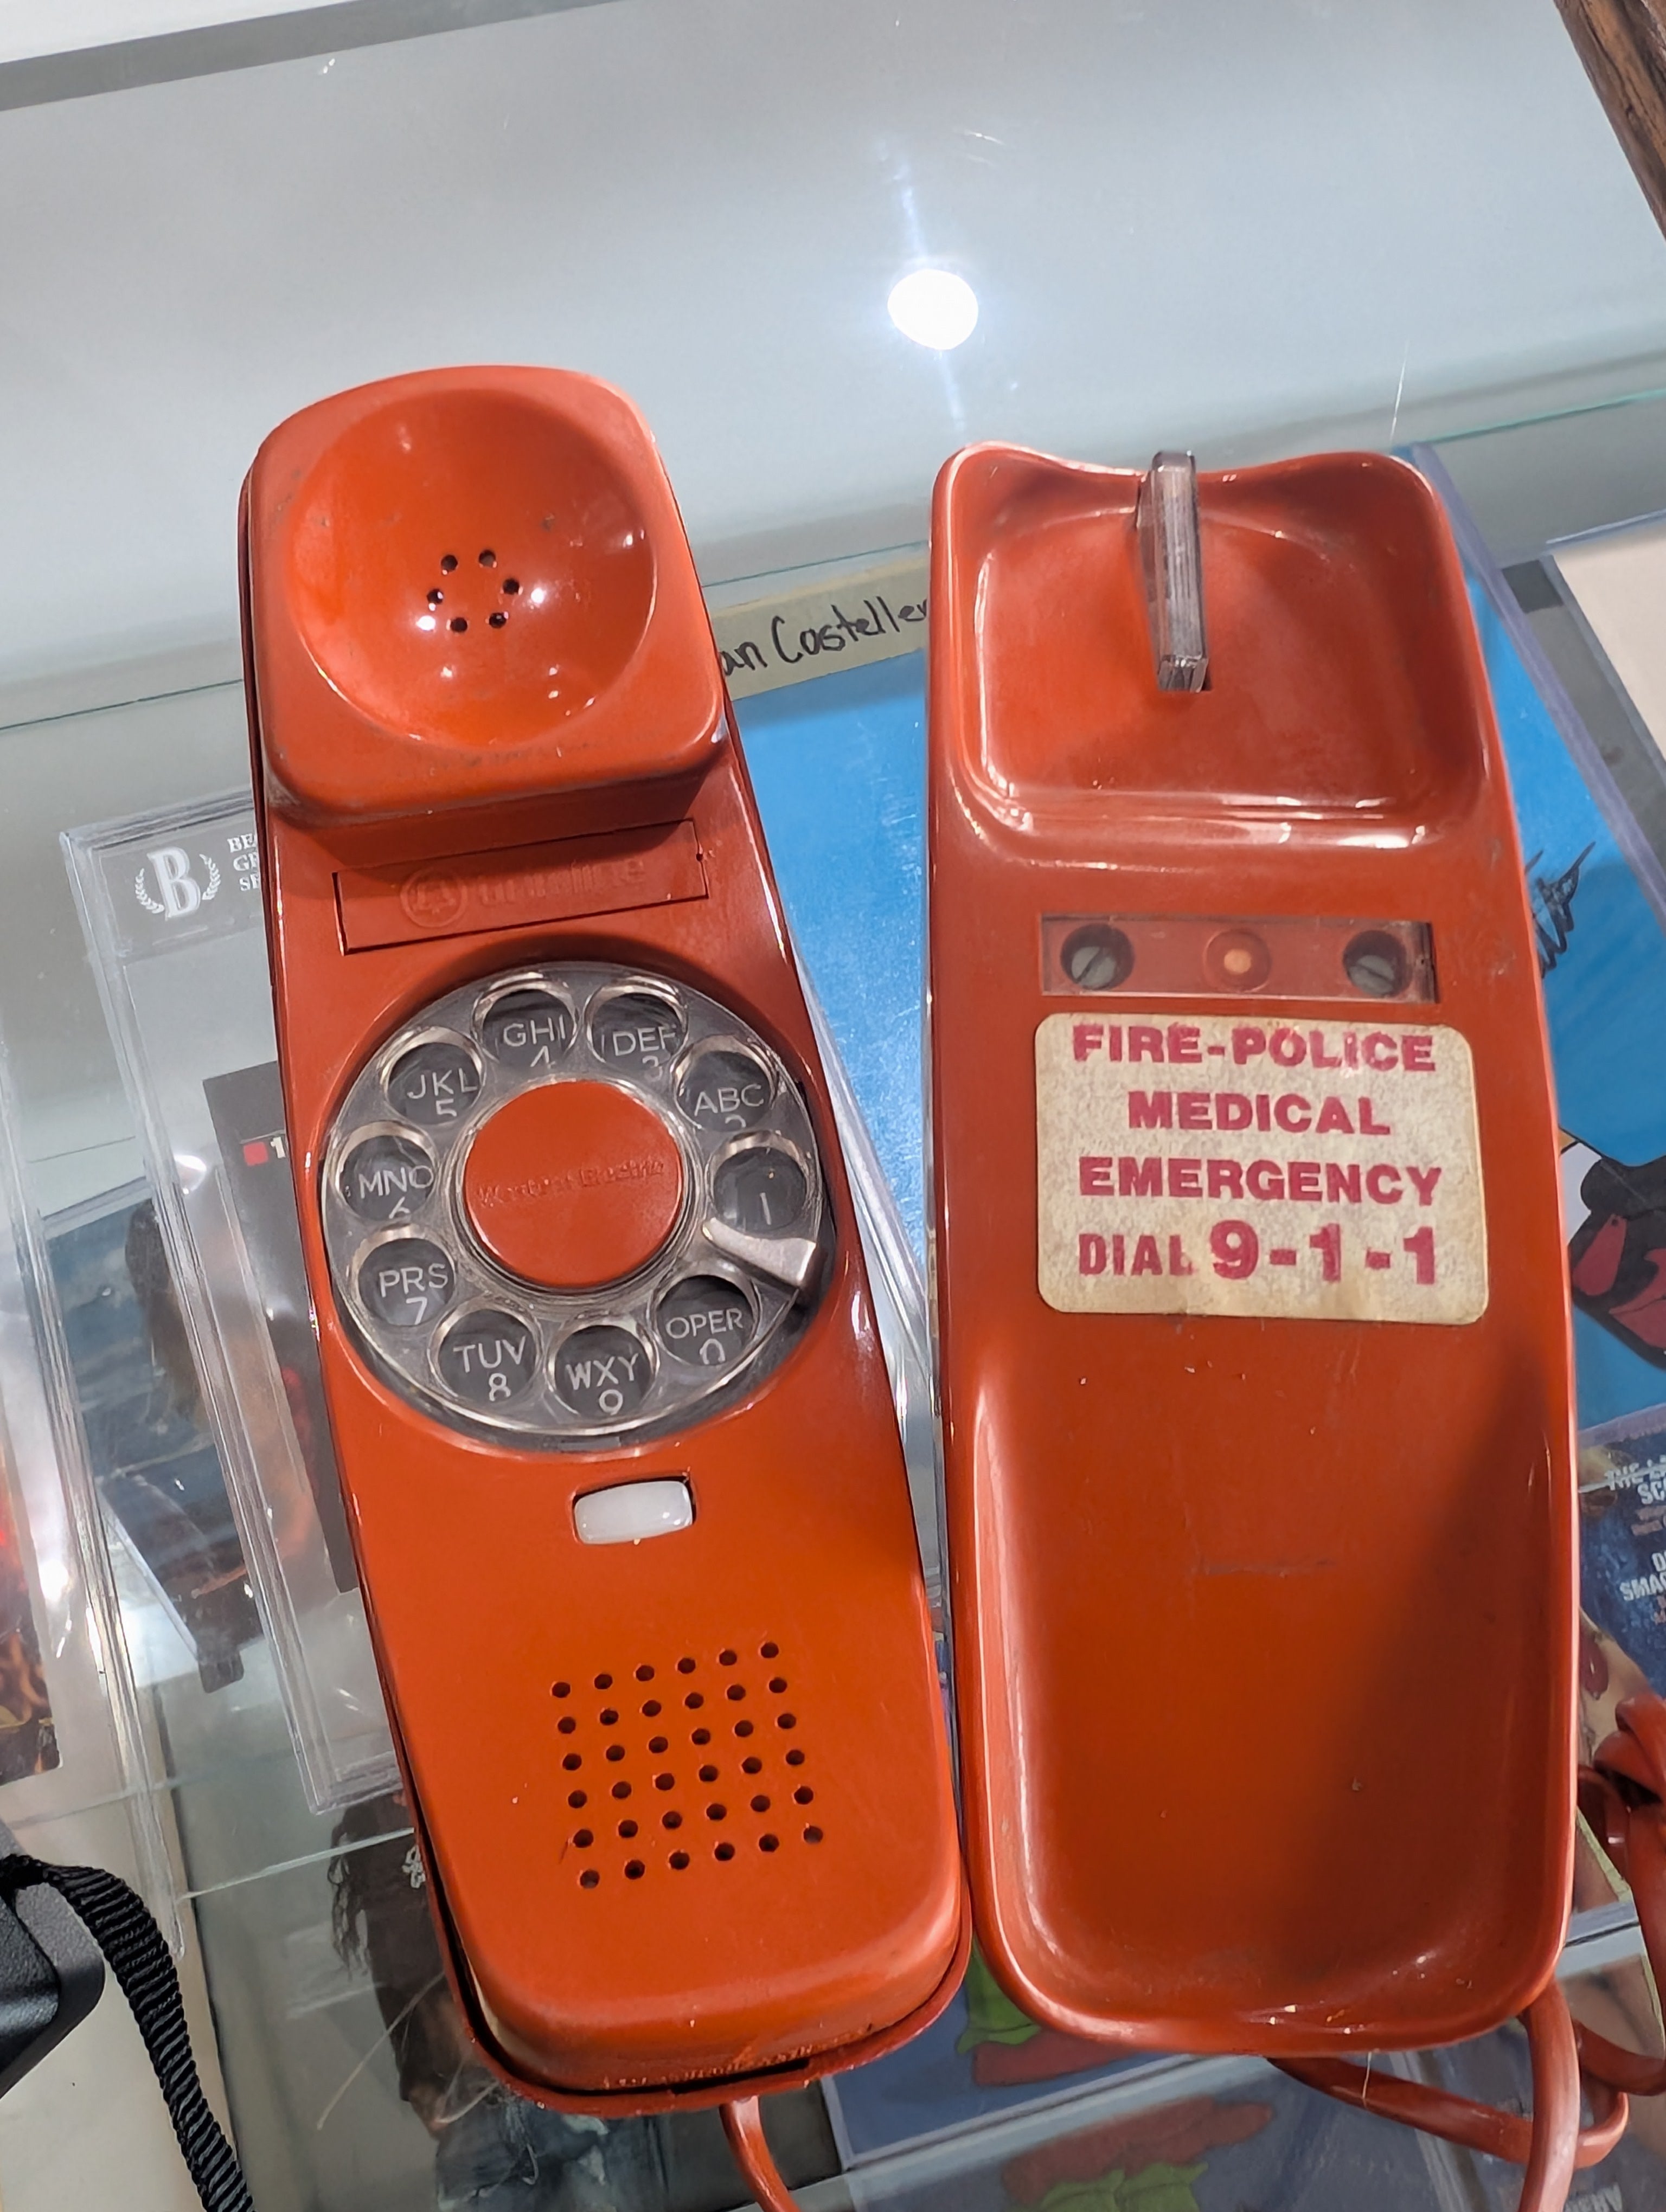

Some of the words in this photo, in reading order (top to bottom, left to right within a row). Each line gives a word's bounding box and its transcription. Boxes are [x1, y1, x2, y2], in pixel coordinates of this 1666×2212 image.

[147, 846, 201, 921] B
[503, 1014, 565, 1047] GHI
[612, 1024, 676, 1056] DEF
[1072, 1023, 1436, 1072] FIRE-POLICE
[407, 1068, 478, 1099] JKL
[694, 1083, 764, 1116] ABC
[1128, 1090, 1391, 1136] MEDICAL
[358, 1165, 434, 1199] MNO
[1079, 1156, 1442, 1207] EMERGENCY
[1078, 1233, 1195, 1277] DIAL
[379, 1263, 448, 1298] PRS
[406, 1296, 428, 1325] 7
[665, 1308, 744, 1339] OPER
[453, 1335, 526, 1373] TUV
[489, 1372, 511, 1401] 8
[565, 1353, 639, 1391] WXY
[1637, 1476, 1666, 1504] SC
